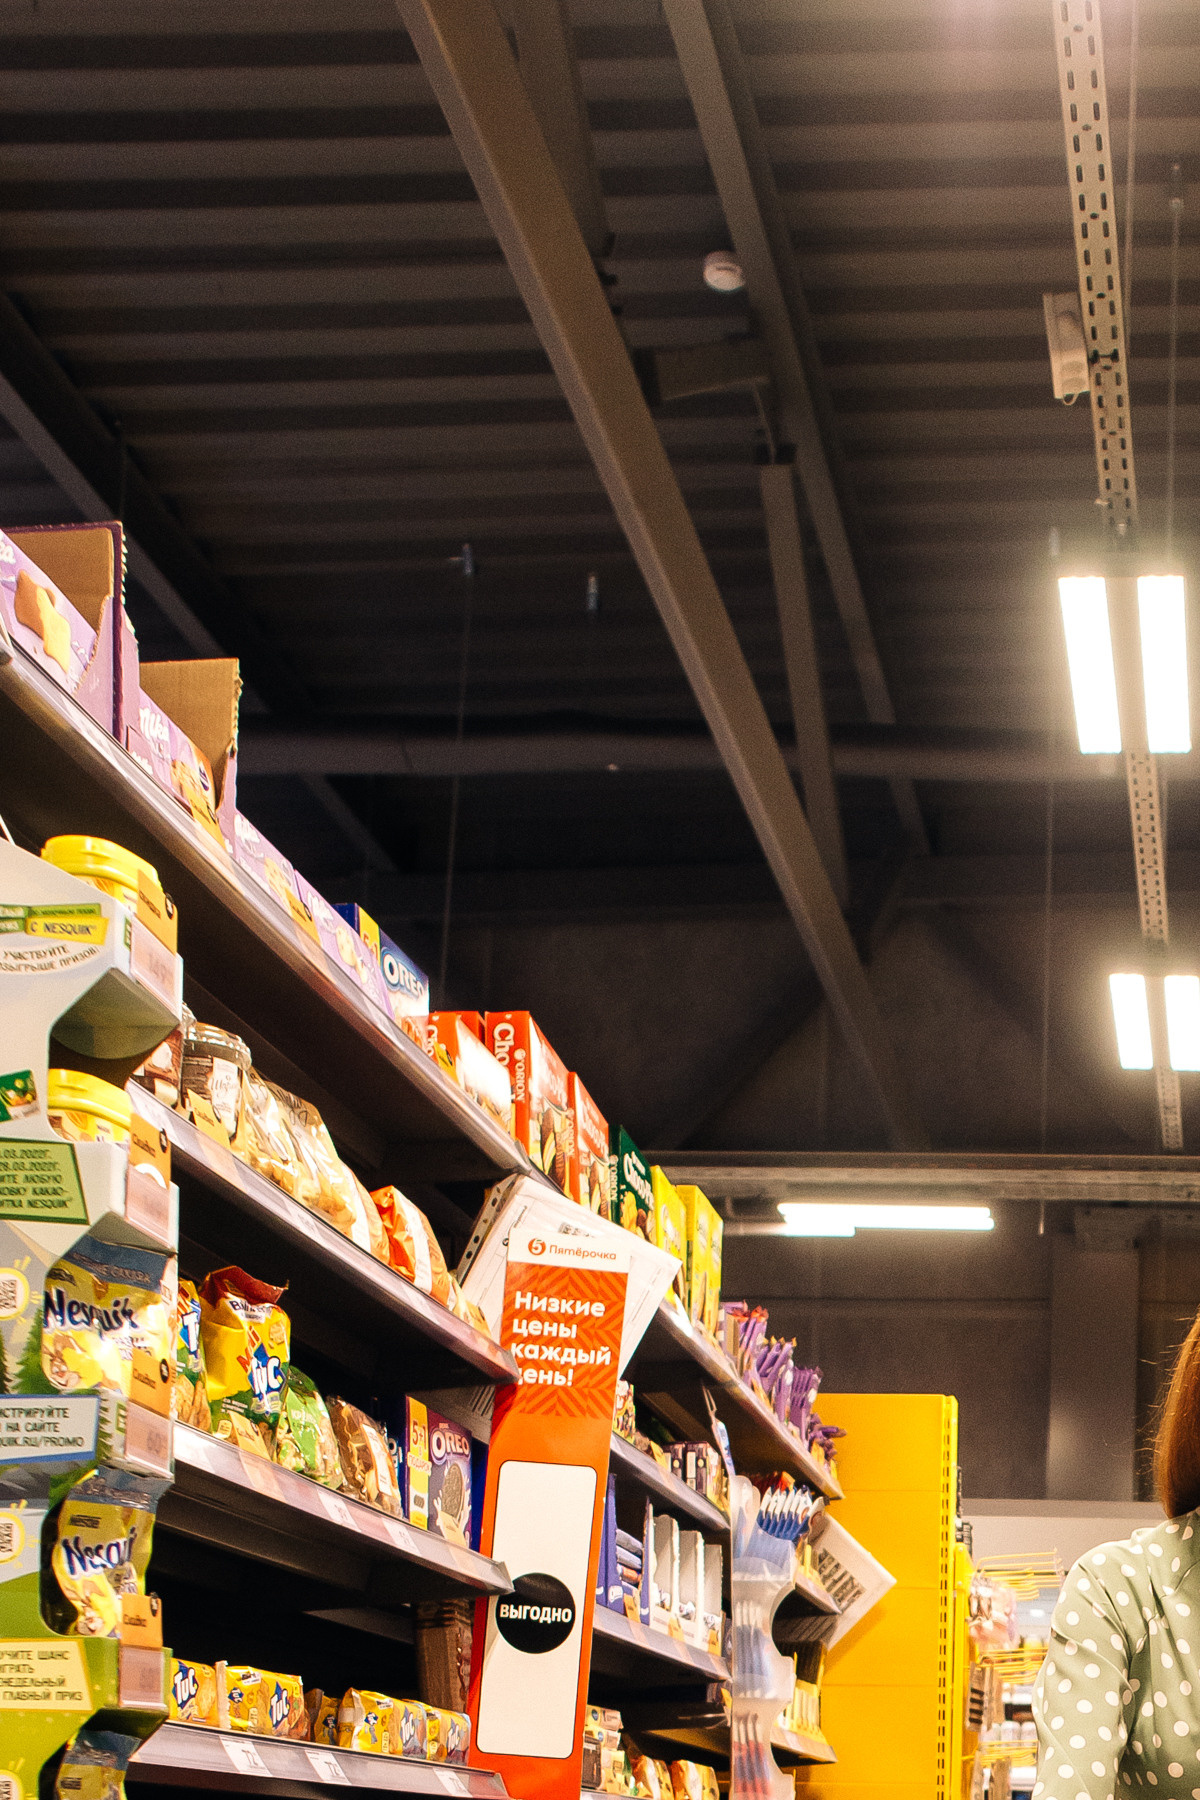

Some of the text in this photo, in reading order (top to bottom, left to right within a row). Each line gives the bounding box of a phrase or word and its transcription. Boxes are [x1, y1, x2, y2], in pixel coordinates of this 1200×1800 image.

[384, 952, 425, 998] OREO
[549, 1244, 618, 1261] Пятёрочка
[514, 1290, 607, 1318] Низкие
[512, 1317, 578, 1340] цены
[510, 1341, 612, 1366] каждый
[431, 1429, 470, 1459] OREO
[499, 1603, 572, 1624] ВЫГОДНО
